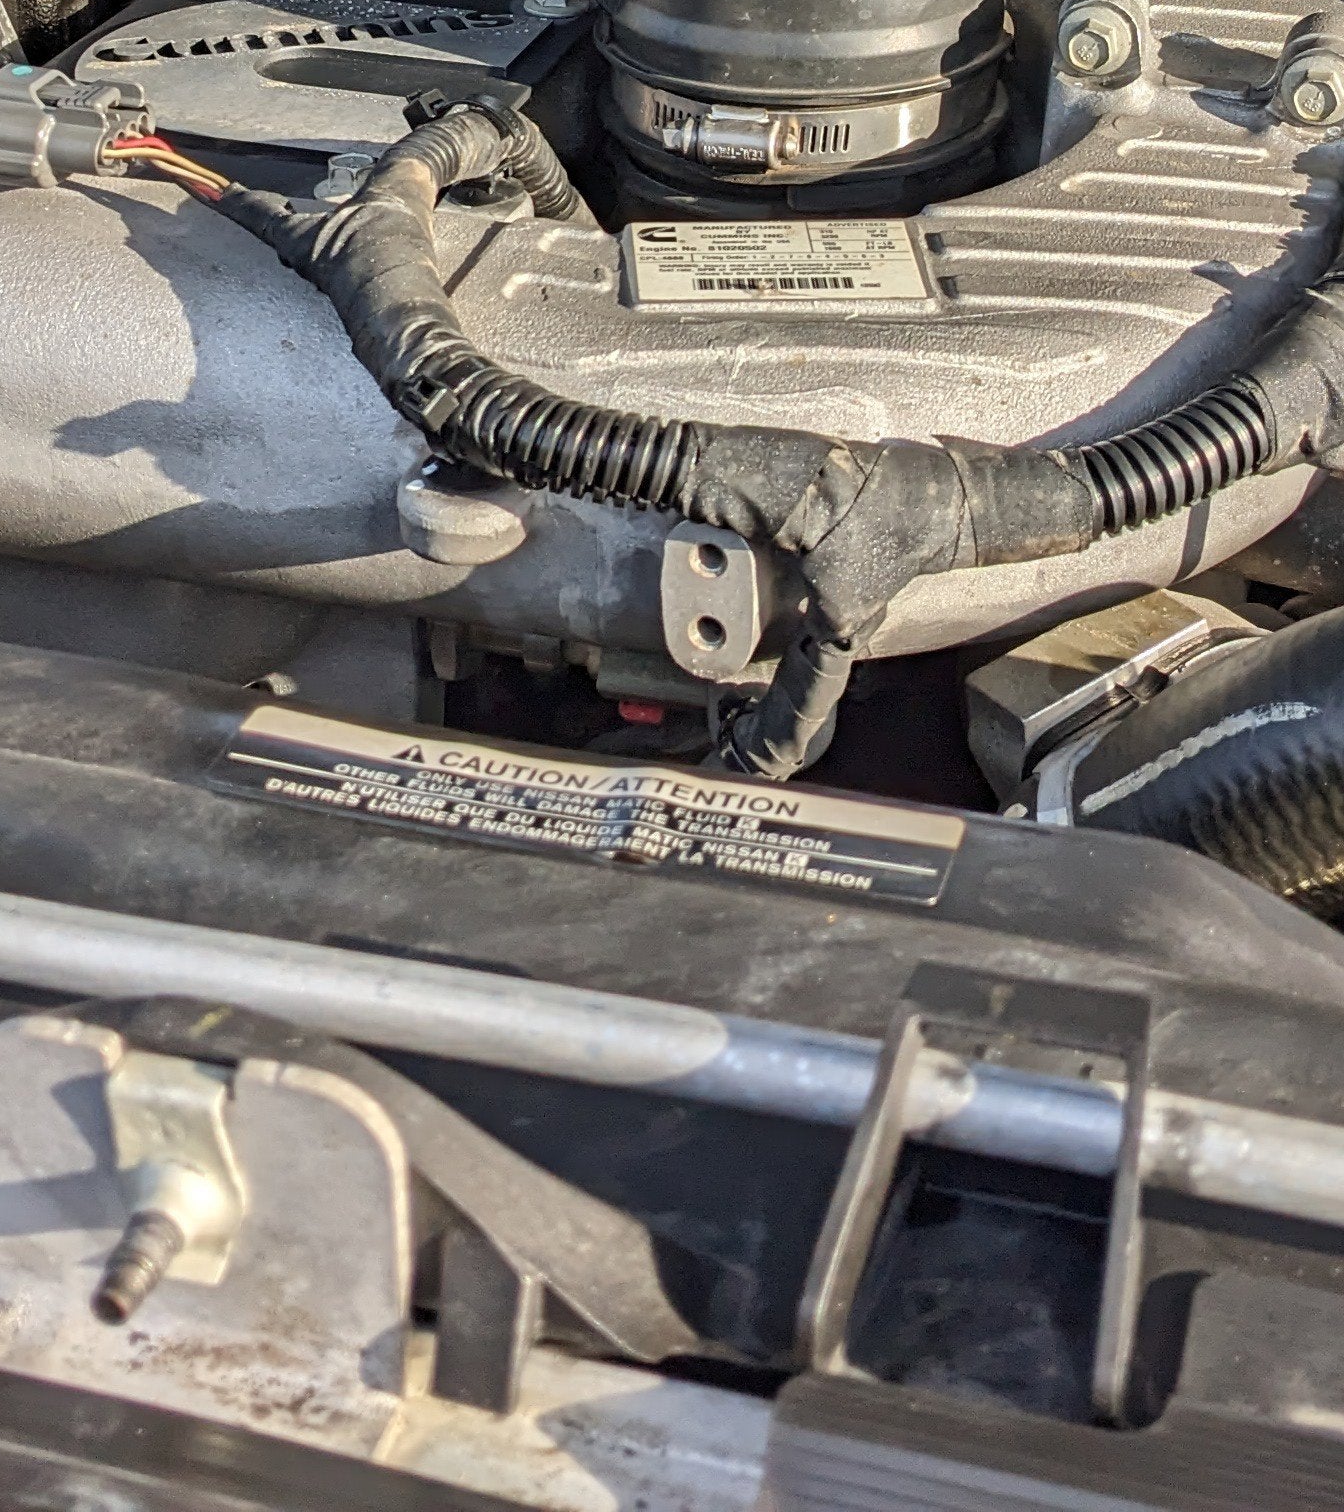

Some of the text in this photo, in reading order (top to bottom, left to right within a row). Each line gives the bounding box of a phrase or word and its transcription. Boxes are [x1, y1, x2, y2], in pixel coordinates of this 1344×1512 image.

[94, 10, 515, 62] Cummins
[333, 763, 832, 854] OTHER FLUIDS WILL DAMAGE THE TRANSMISSION
[415, 769, 467, 787] ONLY
[478, 779, 514, 795] USE
[522, 786, 599, 808] NISSAN
[606, 797, 666, 813] MATIC
[673, 806, 733, 825] FLUID
[264, 777, 362, 808] D'AUTRES
[366, 798, 462, 827] LIQUIDES
[678, 850, 705, 867] LA
[714, 854, 874, 891] TRANSMISSION
[453, 801, 497, 819] QUE
[505, 811, 535, 825] DU
[542, 815, 624, 837] LIQUIDE
[631, 825, 693, 851] MATIC
[702, 840, 781, 863] NISSAN
